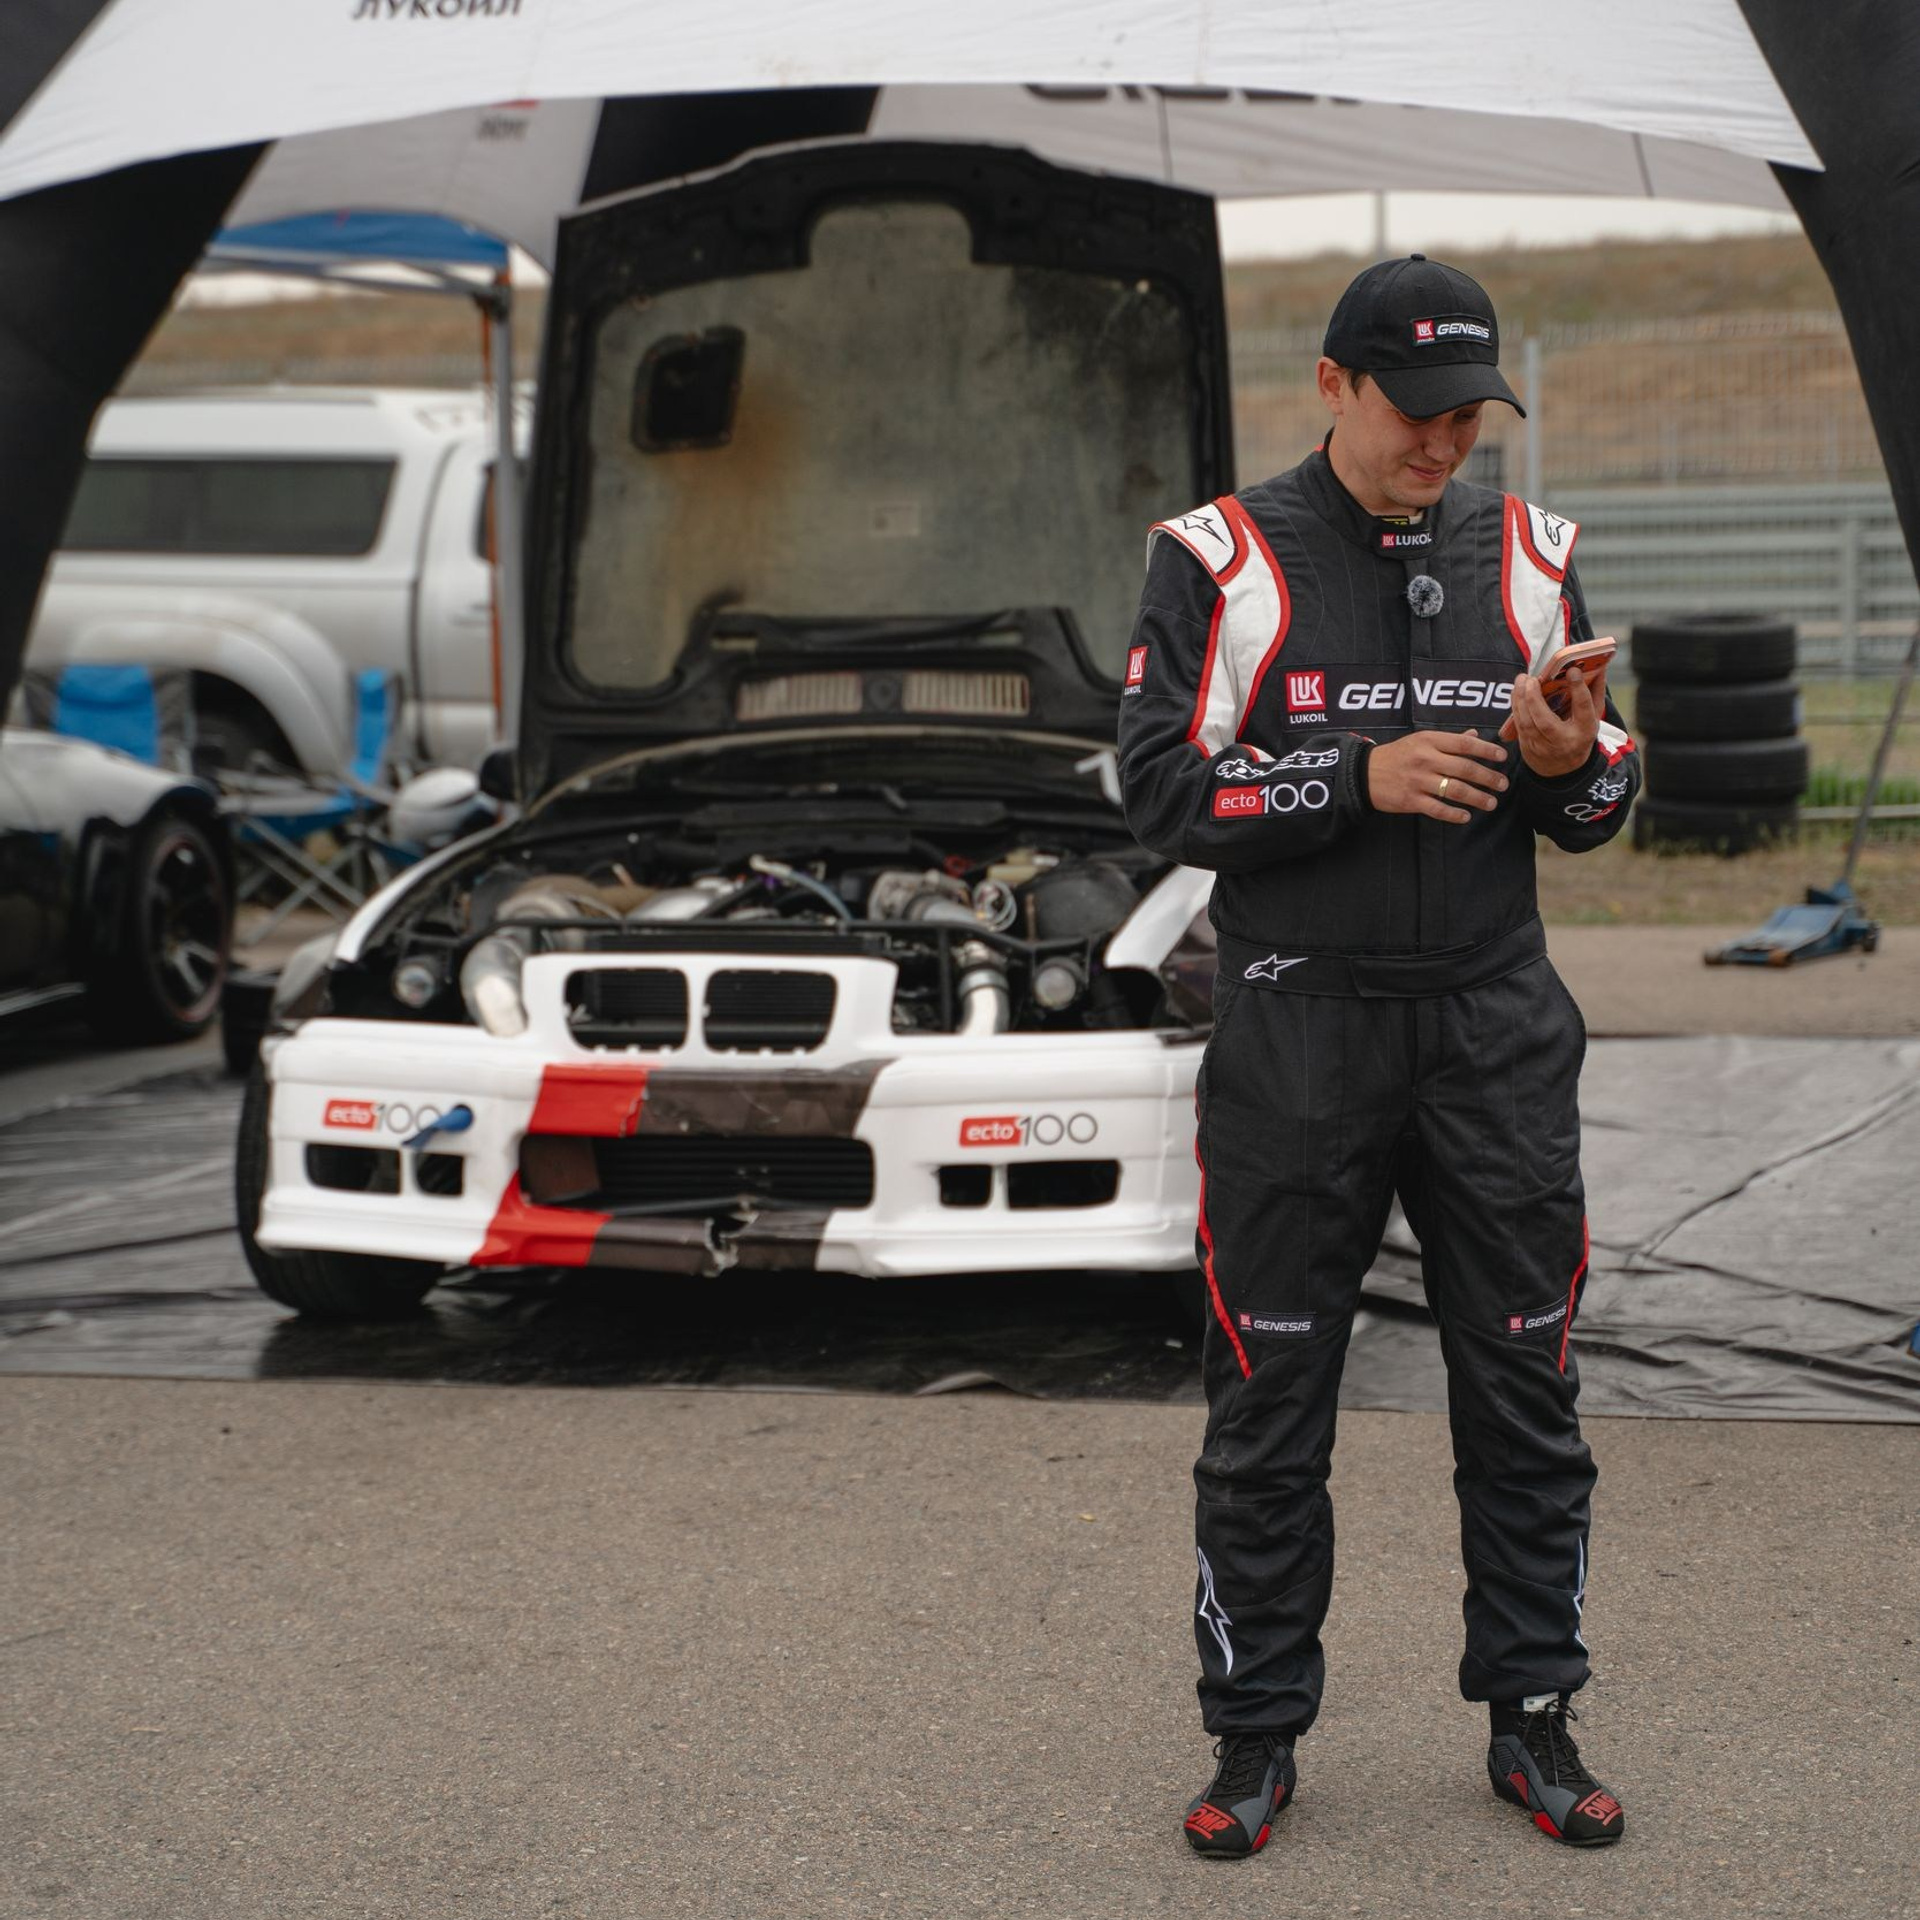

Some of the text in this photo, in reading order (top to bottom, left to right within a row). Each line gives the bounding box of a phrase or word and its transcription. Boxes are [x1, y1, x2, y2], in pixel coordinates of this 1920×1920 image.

[1436, 322, 1490, 339] GENESIS
[1289, 713, 1328, 724] LUKOIL
[1254, 1320, 1312, 1331] GENESIS
[1187, 1807, 1230, 1833] OMP
